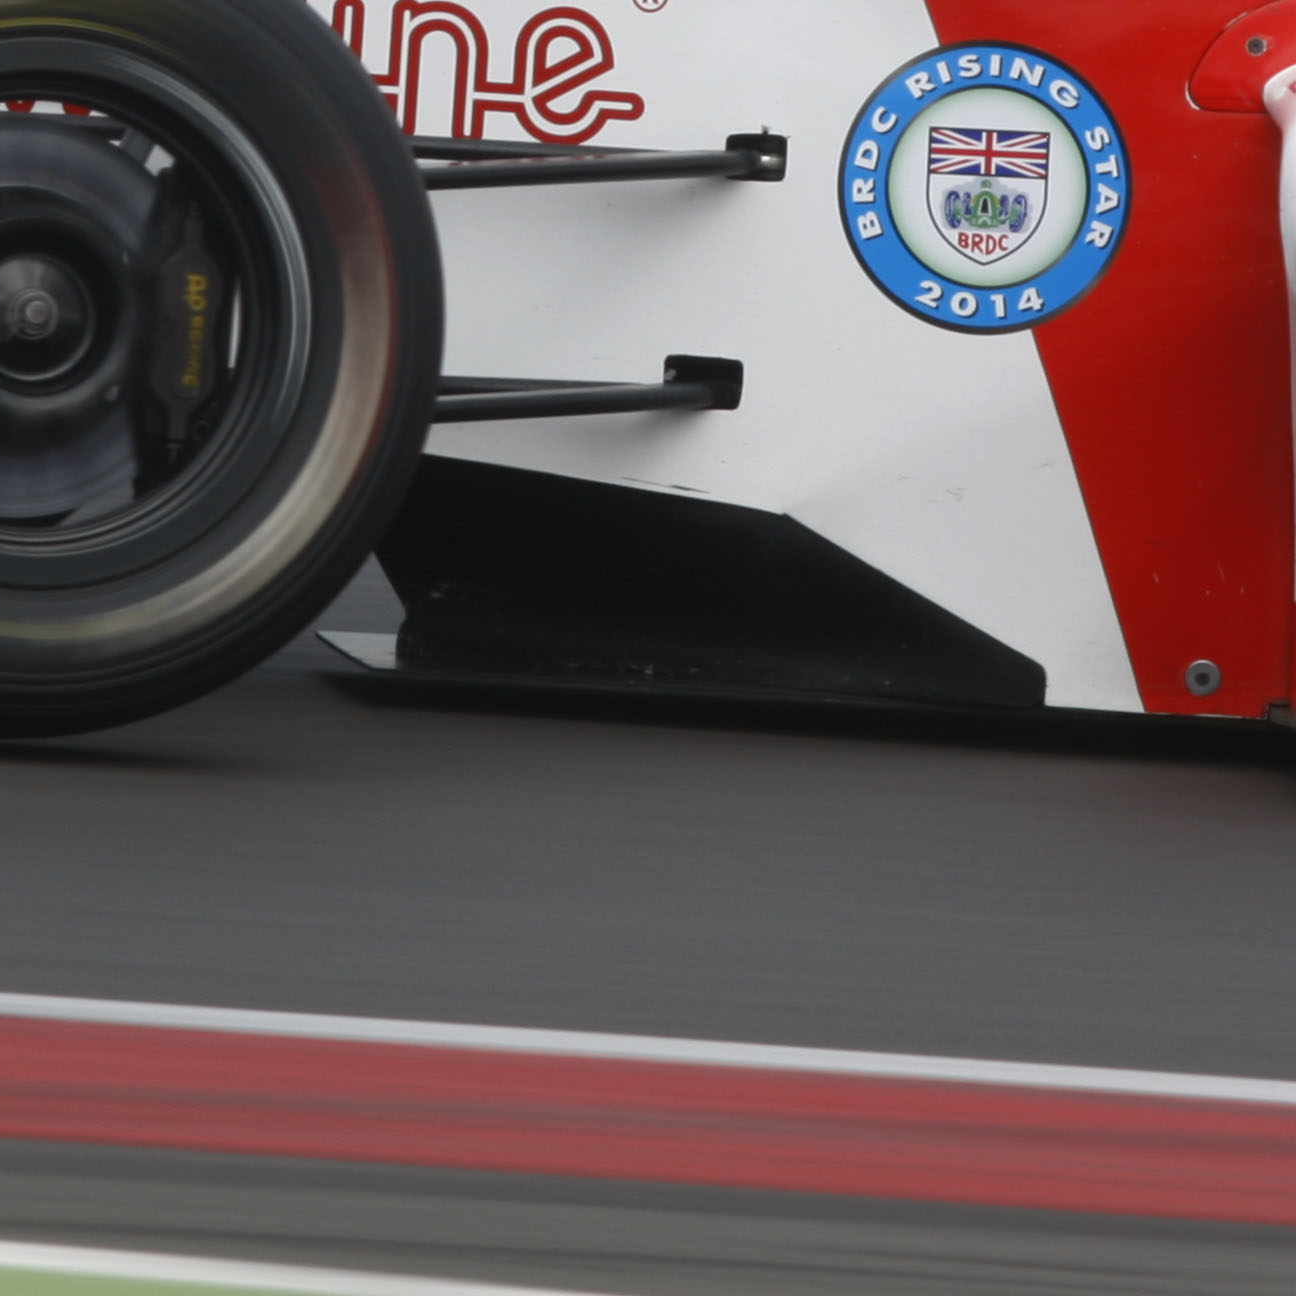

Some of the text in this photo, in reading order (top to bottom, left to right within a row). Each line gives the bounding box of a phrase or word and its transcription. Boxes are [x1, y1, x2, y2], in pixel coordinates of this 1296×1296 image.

[851, 53, 1121, 249] BRDC RISING STAR
[956, 231, 1011, 257] BRDC
[914, 279, 1046, 319] 2014
